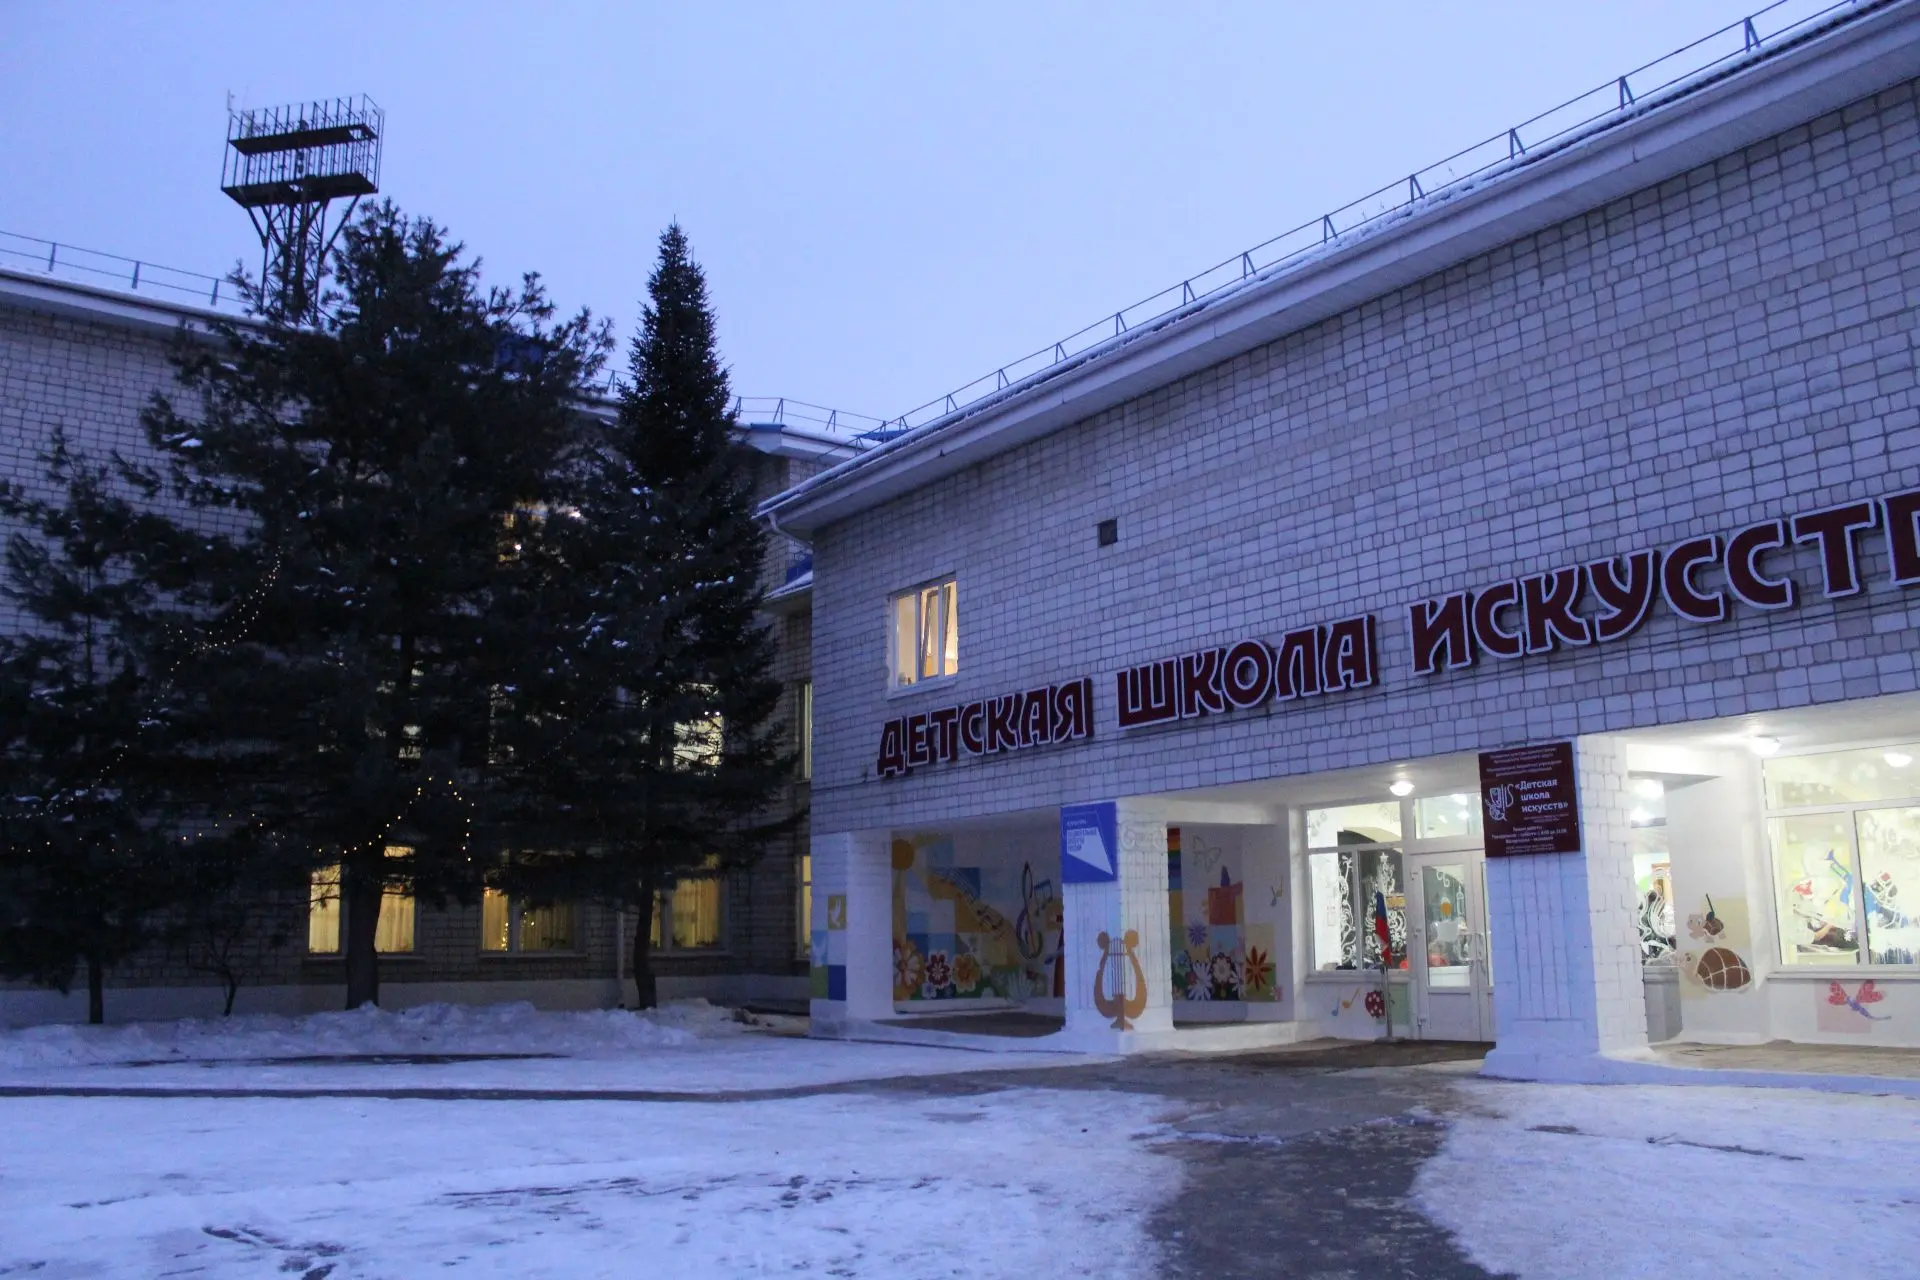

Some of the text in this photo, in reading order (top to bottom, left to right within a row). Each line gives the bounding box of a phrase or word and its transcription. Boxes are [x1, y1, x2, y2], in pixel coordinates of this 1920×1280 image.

[877, 678, 1092, 777] ДЕТСКАЯ
[1116, 614, 1377, 728] ШКОЛА
[1521, 792, 1550, 801] школа
